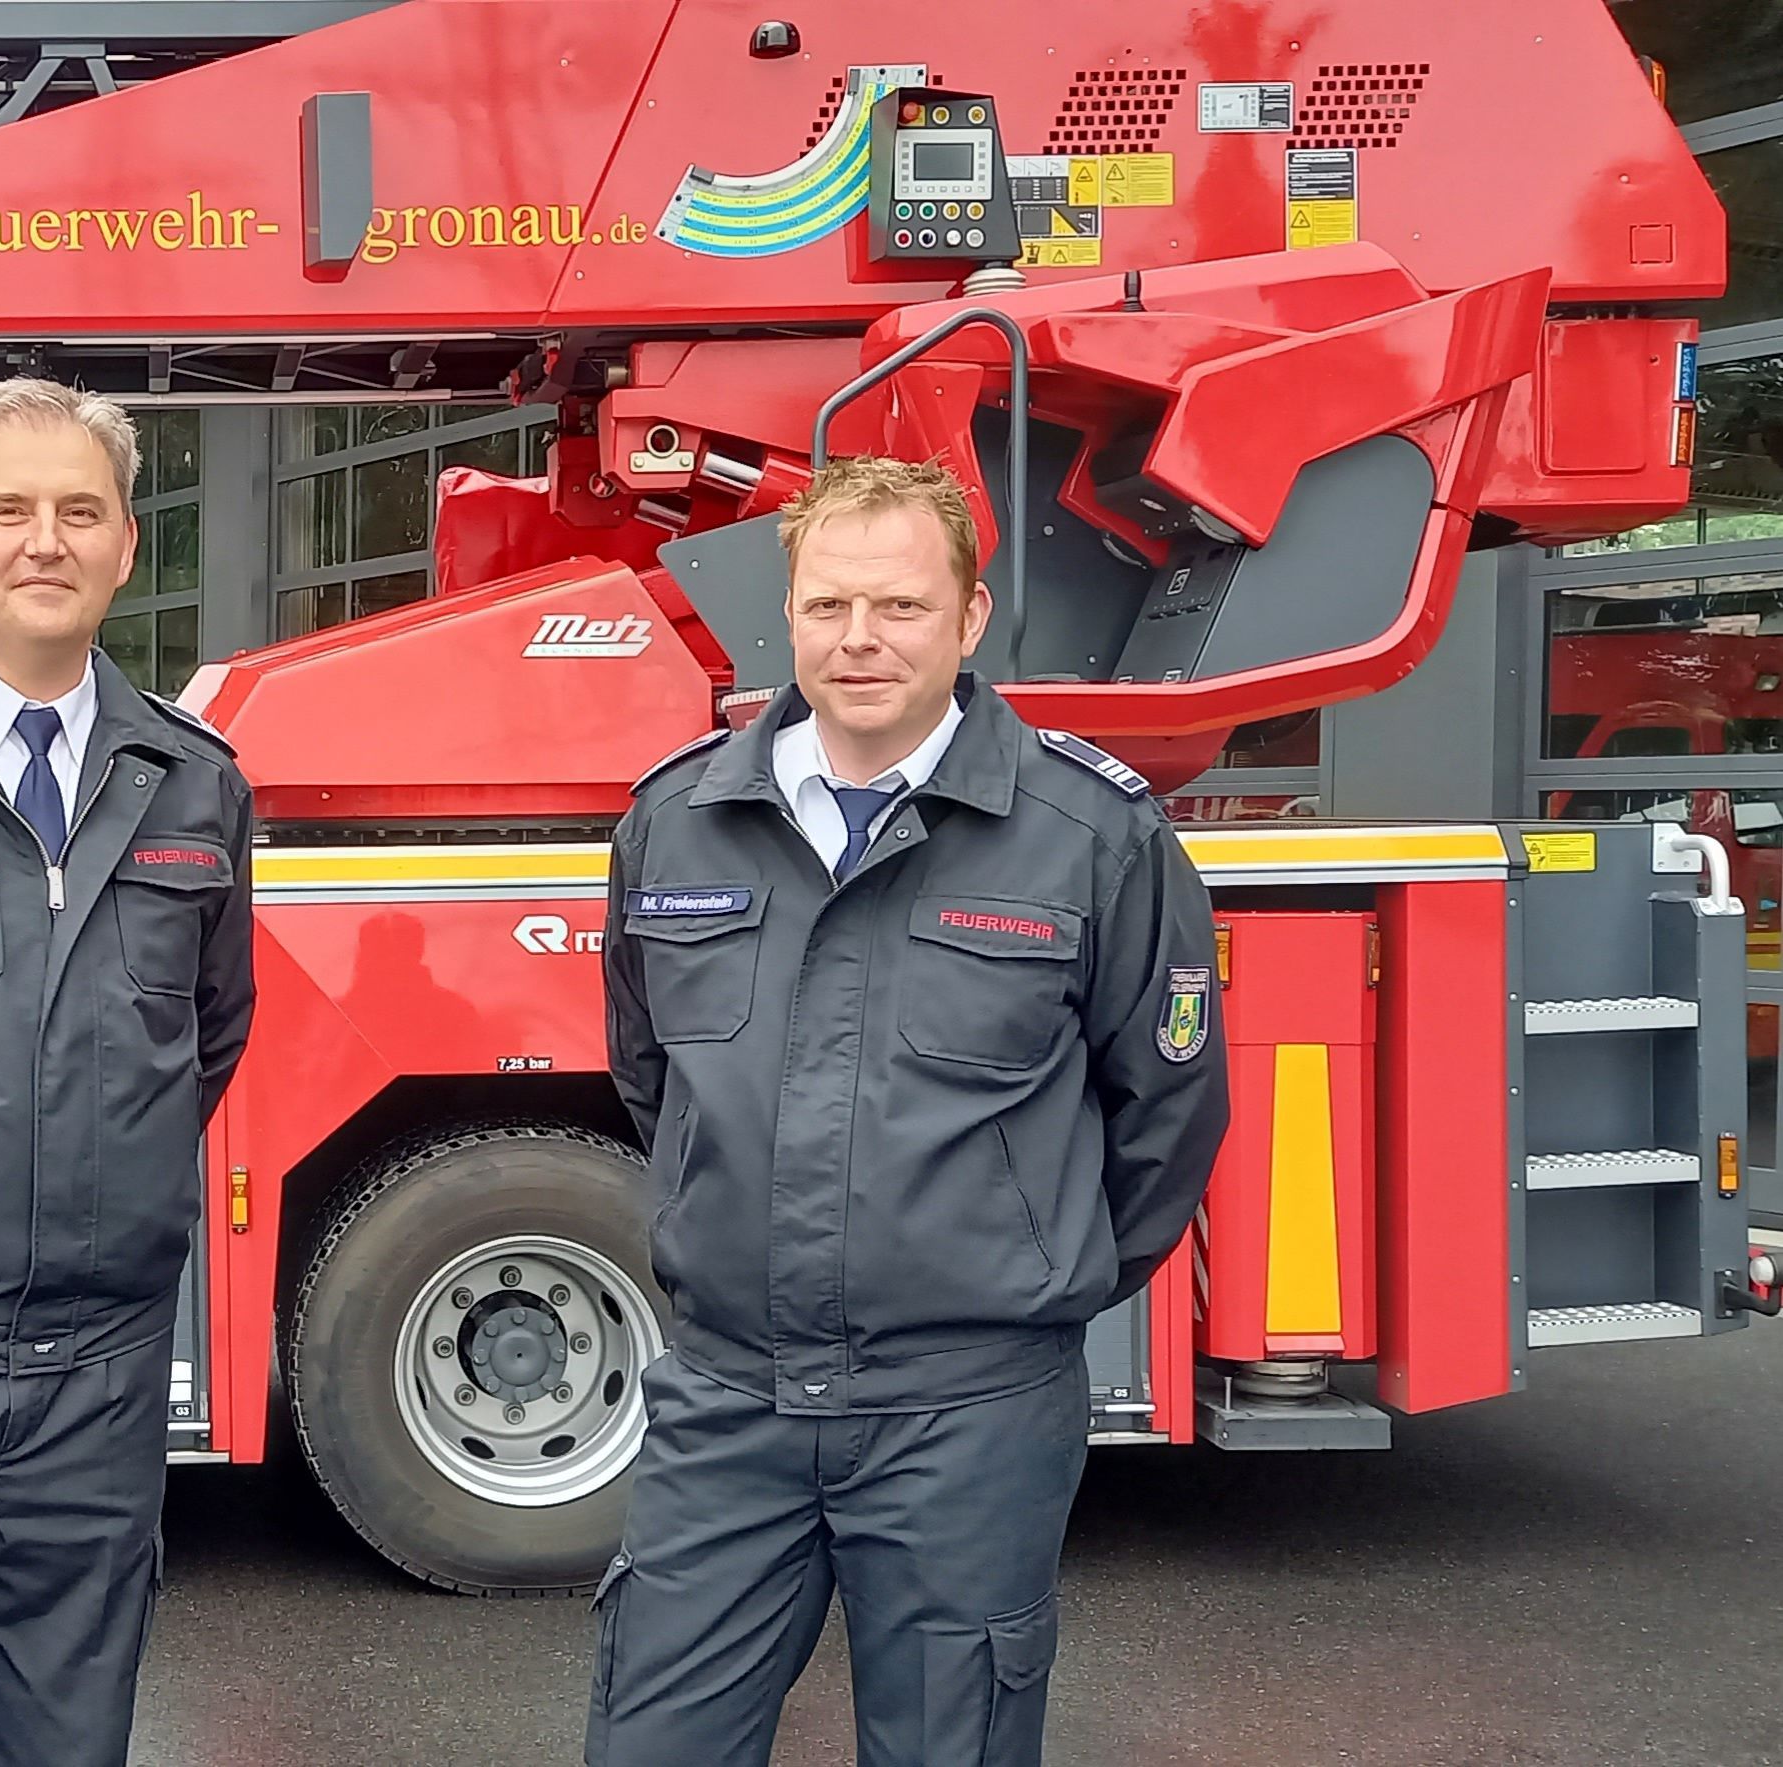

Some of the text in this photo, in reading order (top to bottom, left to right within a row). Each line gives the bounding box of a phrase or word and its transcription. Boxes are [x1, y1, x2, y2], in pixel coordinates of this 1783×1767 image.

[530, 612, 654, 644] Metz
[939, 911, 1054, 942] FEUERWEHR
[497, 1058, 552, 1072] 7,25 bar
